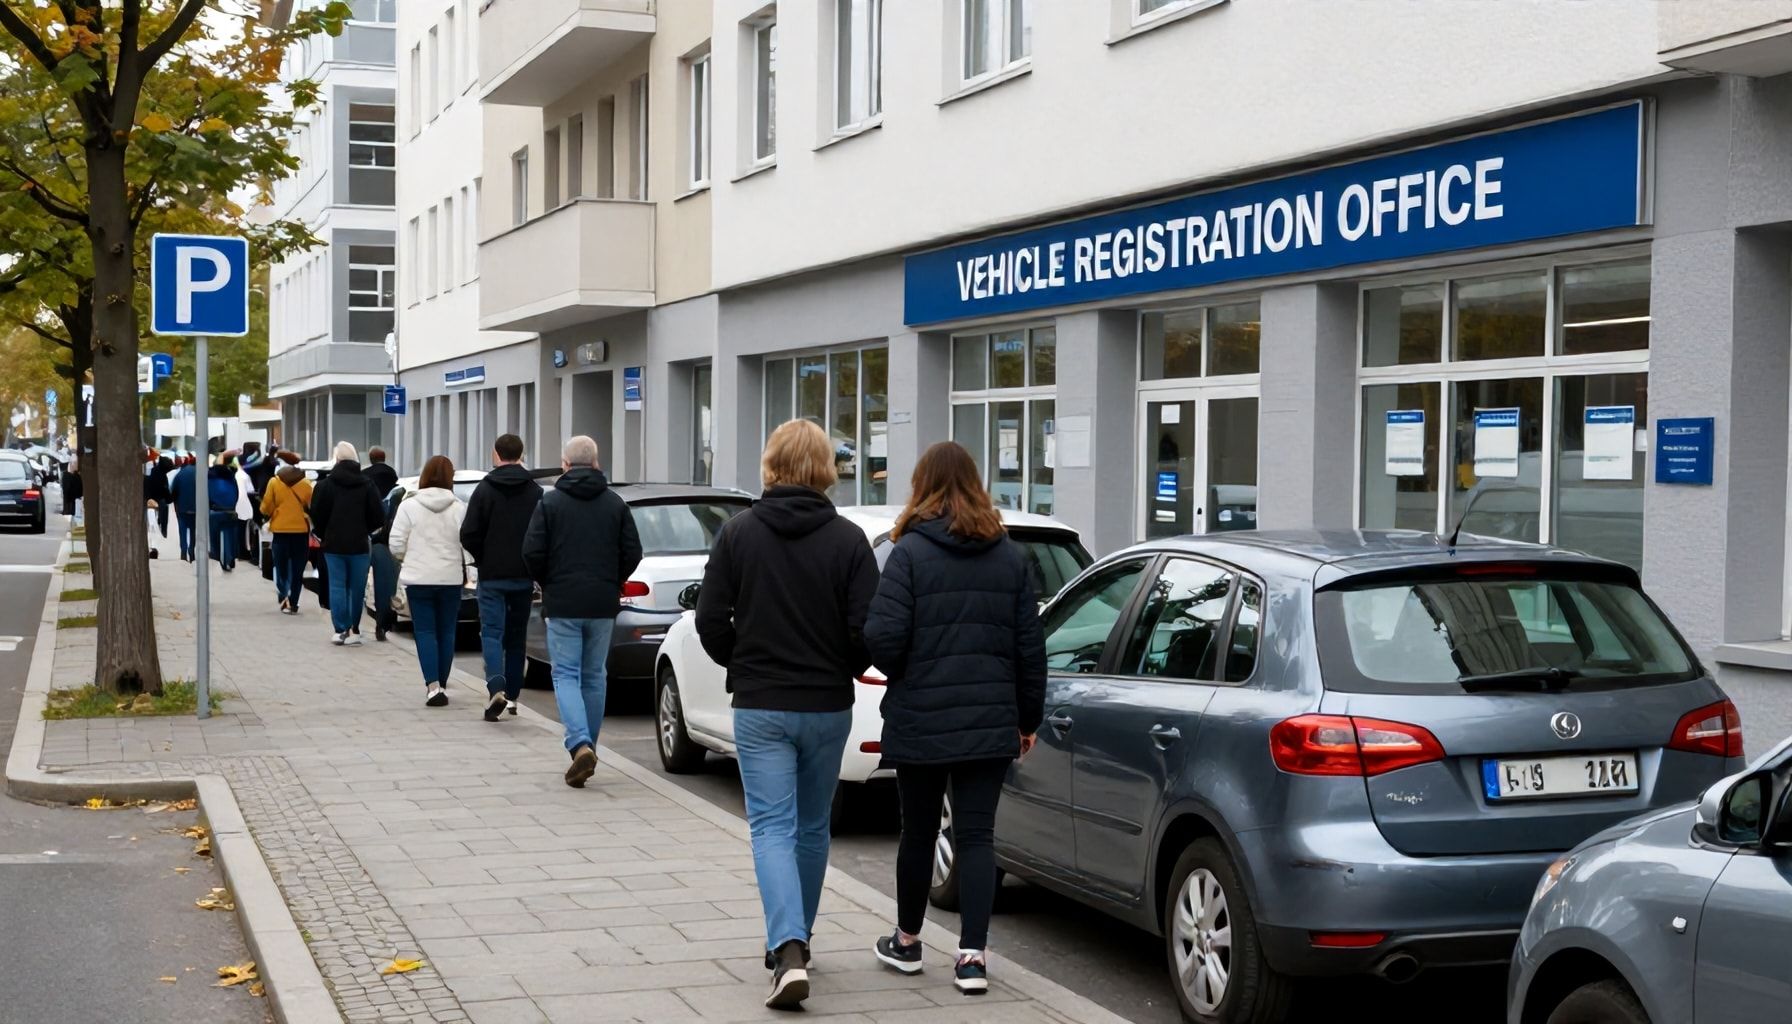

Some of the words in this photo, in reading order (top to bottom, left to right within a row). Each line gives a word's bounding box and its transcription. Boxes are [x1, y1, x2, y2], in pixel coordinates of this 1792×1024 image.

[957, 241, 1066, 301] VEHICLE
[1074, 191, 1323, 283] REGISTRATION
[1337, 157, 1504, 242] OFFICE
[176, 246, 231, 324] P
